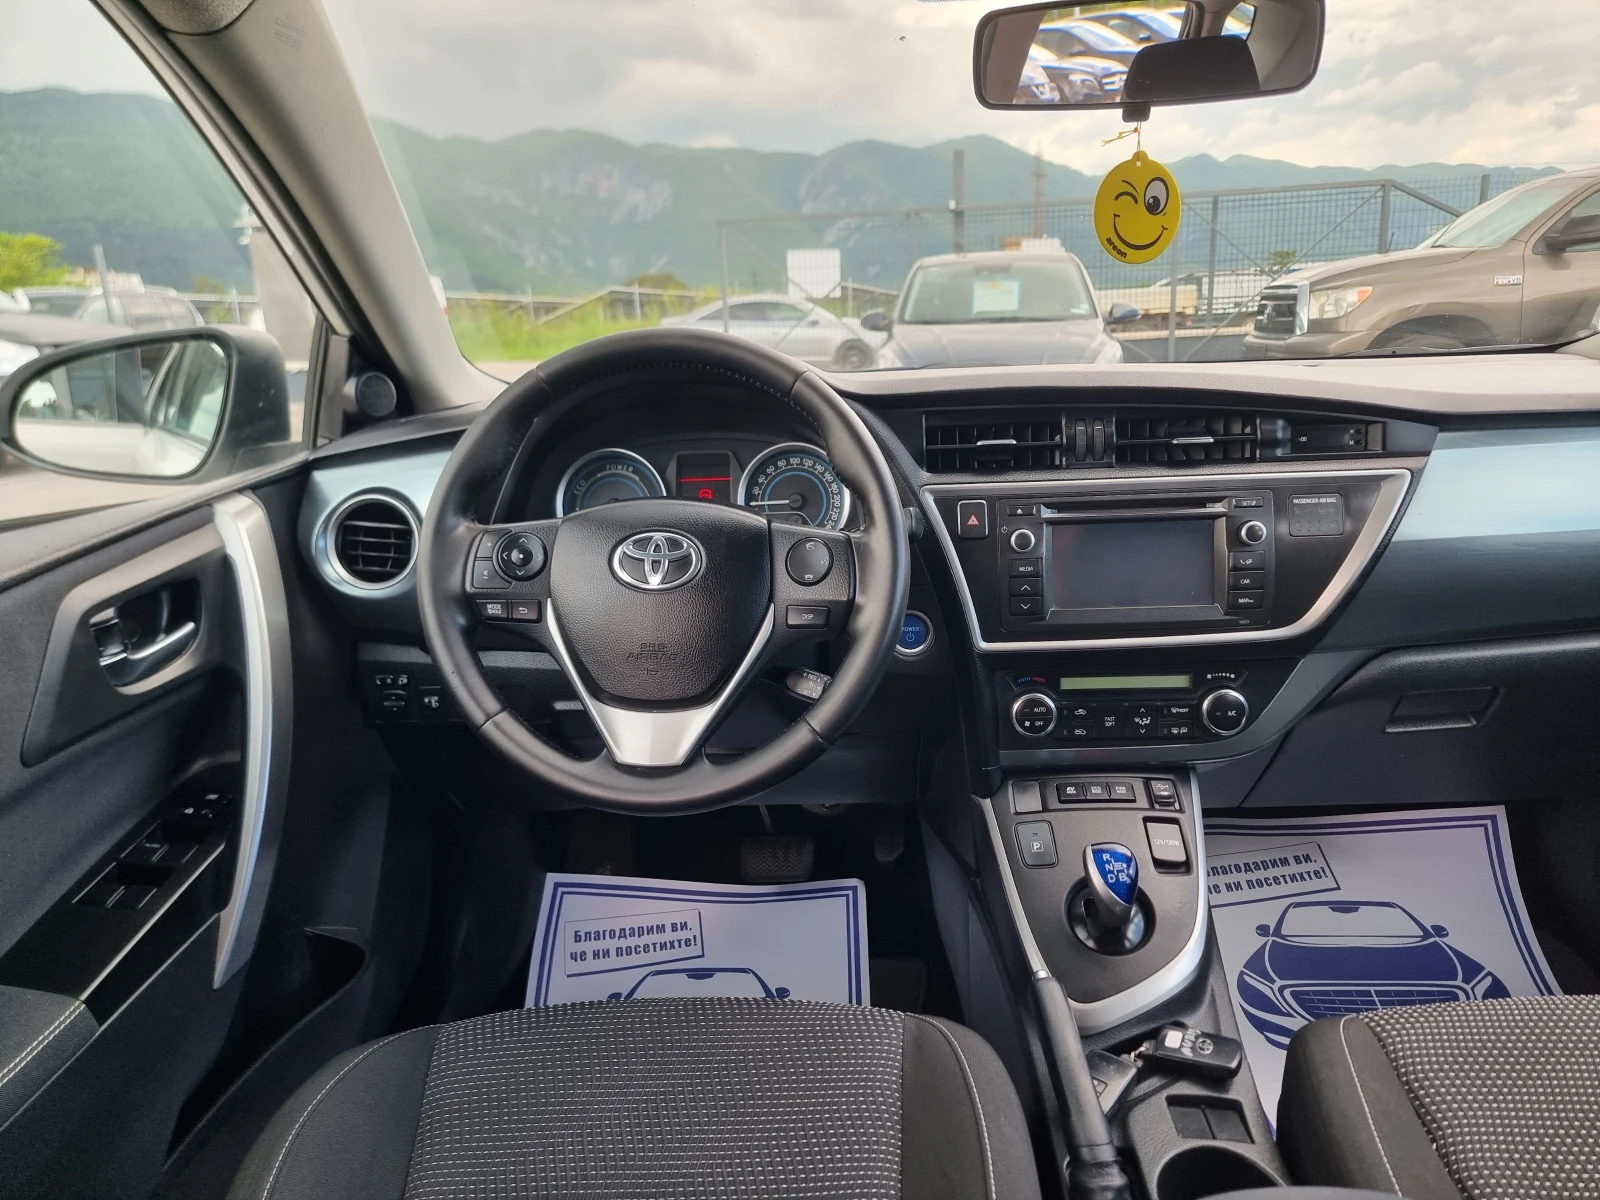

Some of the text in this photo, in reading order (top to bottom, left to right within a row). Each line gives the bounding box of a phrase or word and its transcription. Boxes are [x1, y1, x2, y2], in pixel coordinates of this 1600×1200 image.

[1105, 236, 1128, 259] areon
[777, 459, 787, 467] 80
[802, 458, 814, 467] 120
[814, 463, 825, 473] 140
[606, 464, 634, 473] POWER
[766, 465, 775, 474] 60
[758, 474, 766, 484] 40
[824, 471, 834, 482] 160
[573, 479, 586, 496] ECO
[752, 486, 760, 496] 20
[830, 481, 839, 494] 180
[833, 494, 841, 508] 200
[830, 508, 840, 523] 220
[1033, 842, 1041, 851] P
[1102, 853, 1111, 862] R
[1293, 853, 1317, 865] ви,
[1104, 862, 1114, 872] N
[1107, 872, 1127, 883] D B
[1224, 881, 1244, 893] ни
[1246, 866, 1329, 890] посетихте!
[574, 920, 693, 943] Благодарим ви,
[570, 934, 698, 962] че ни посетихте!
